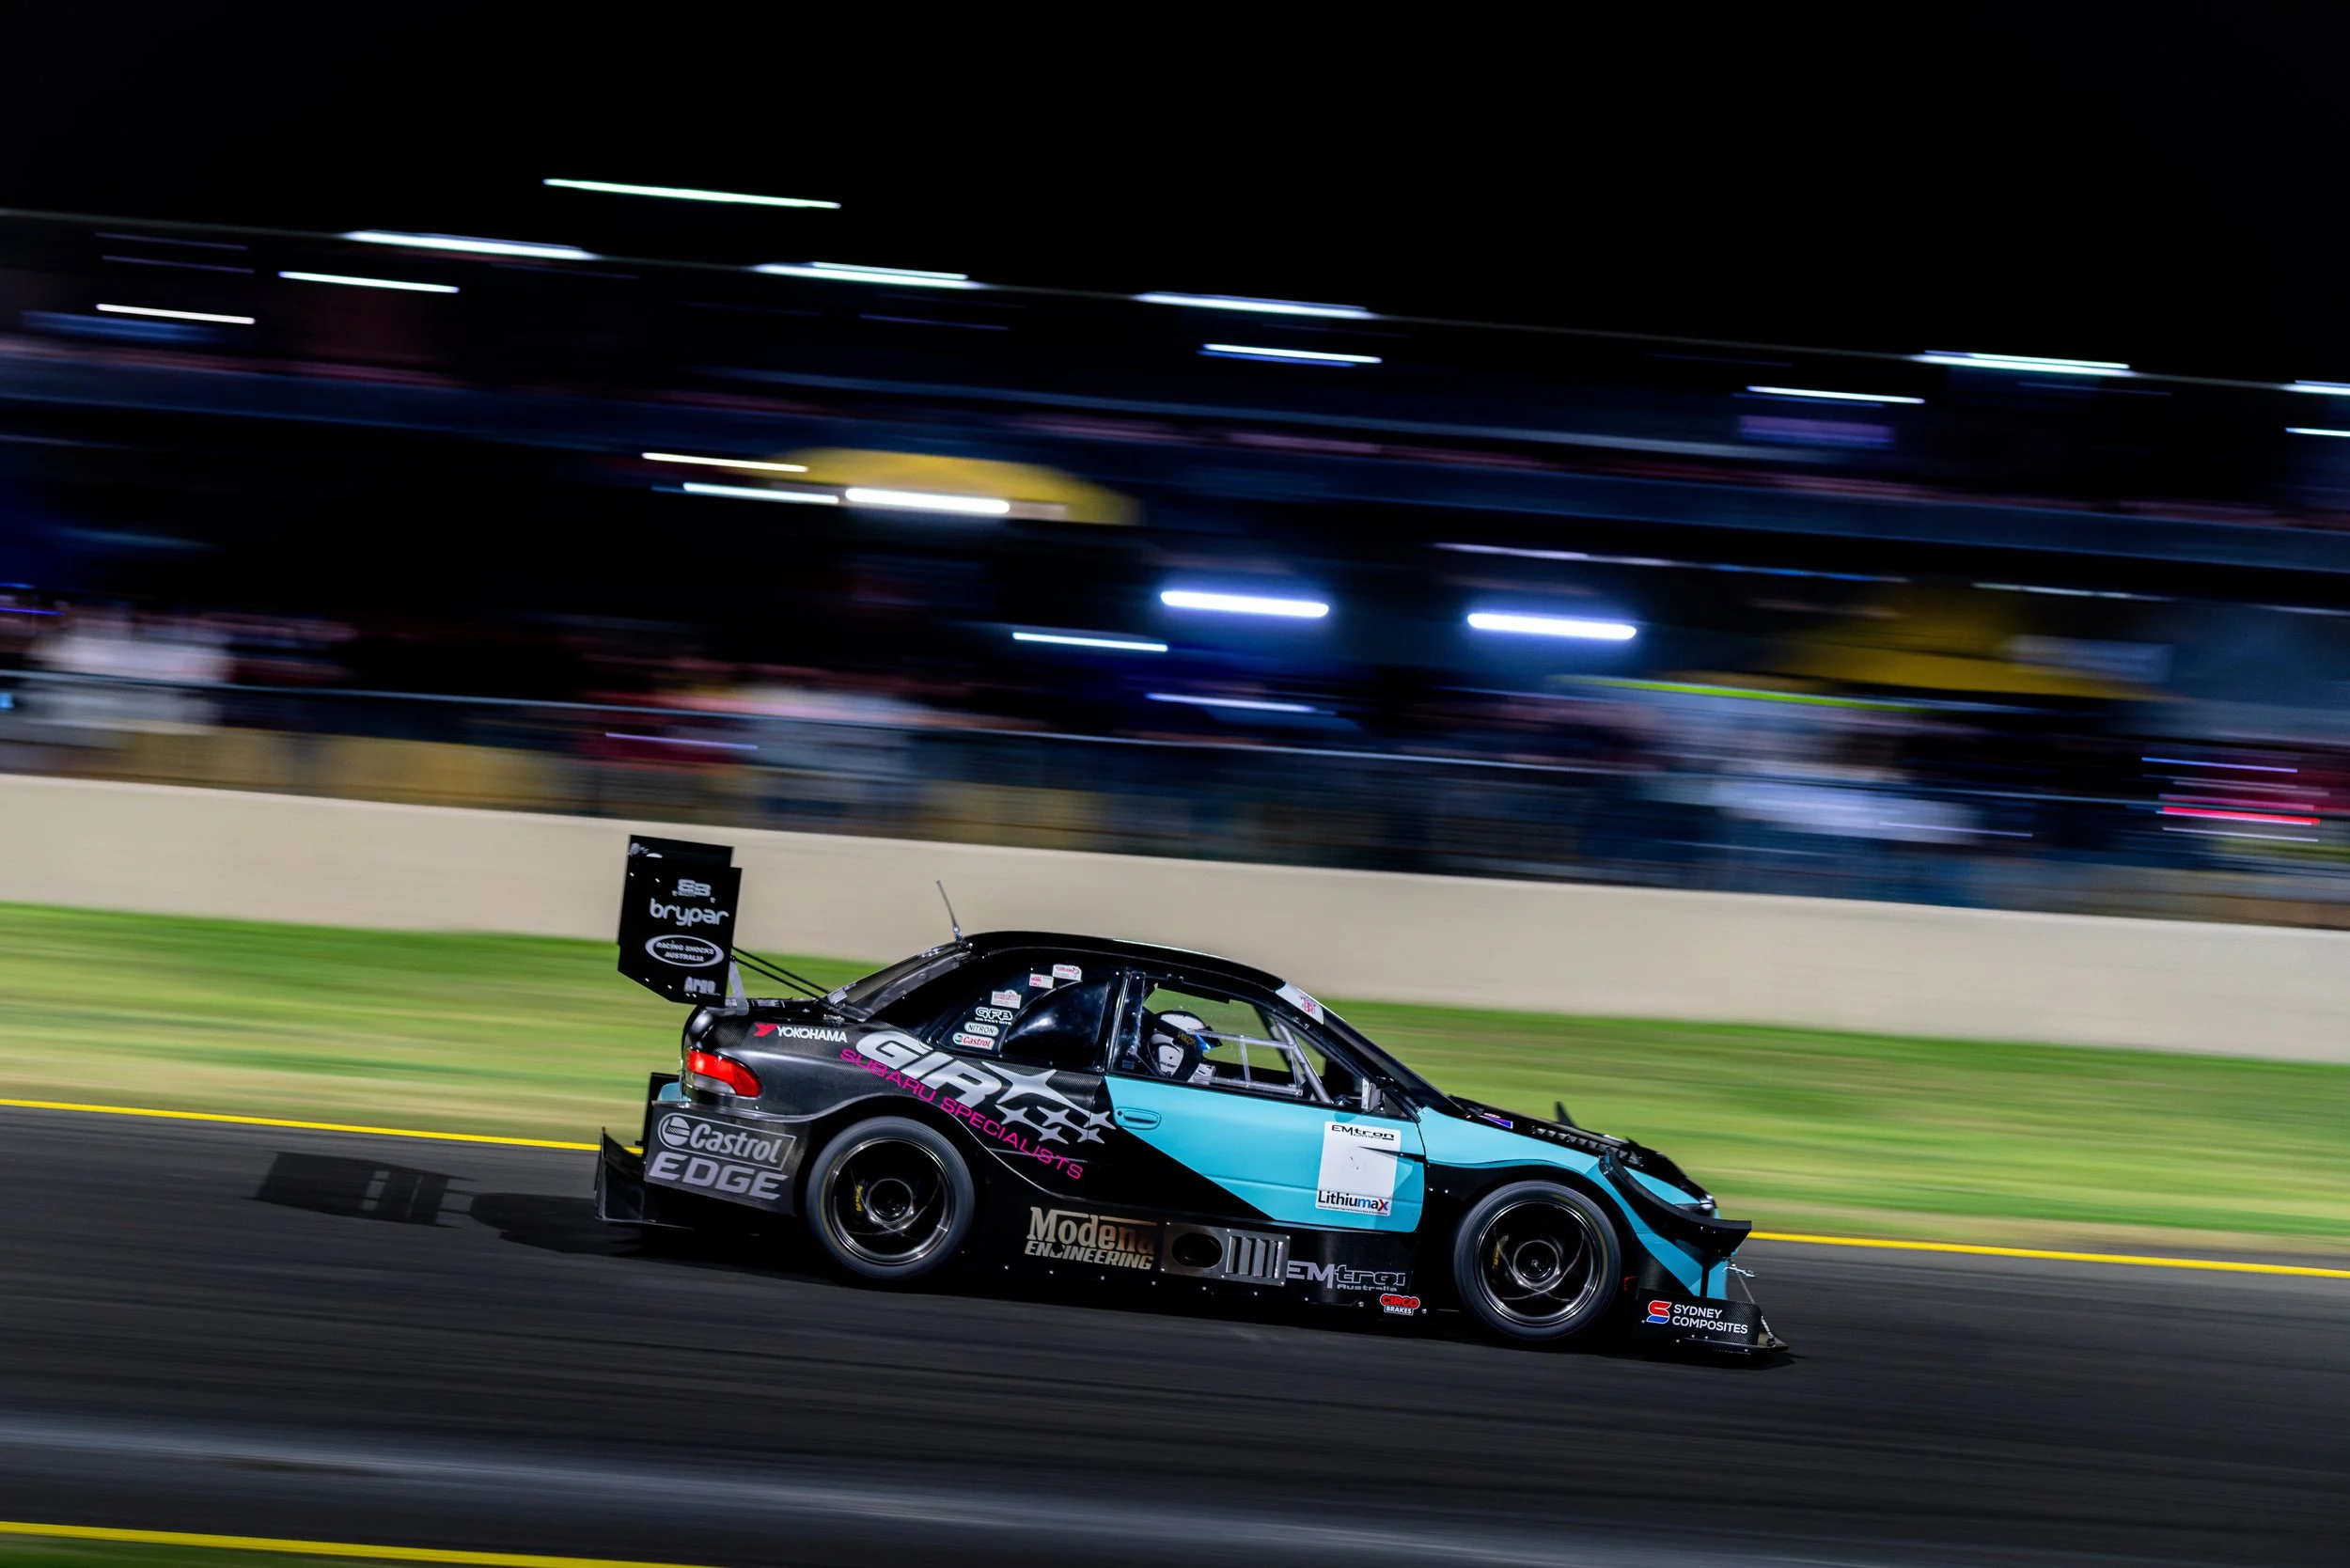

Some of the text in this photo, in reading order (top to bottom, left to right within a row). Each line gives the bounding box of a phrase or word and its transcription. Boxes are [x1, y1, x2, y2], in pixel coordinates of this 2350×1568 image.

[649, 898, 729, 927] brypar
[656, 941, 715, 955] RACING SHOCKS
[664, 951, 704, 962] AUSTRALIA
[975, 1006, 1012, 1021] GFB
[777, 1026, 848, 1043] YOKOHAMA
[968, 1024, 994, 1034] NITRON
[963, 1036, 992, 1047] Castrol
[855, 1030, 1003, 1109] GIR
[839, 1048, 1084, 1180] SUBARU SPECIALISTS
[1331, 1124, 1394, 1140] EMtron
[689, 1123, 782, 1164] Castrol
[649, 1151, 790, 1200] EDGE
[1318, 1190, 1389, 1211] Lithiumax
[1026, 1206, 1157, 1255] Modena
[1337, 1283, 1398, 1293] Australia
[1380, 1294, 1419, 1309] CIRCO
[1386, 1306, 1412, 1314] BRAKES
[1673, 1304, 1723, 1319] SYDNEY
[1672, 1316, 1748, 1334] COMPOSITES
